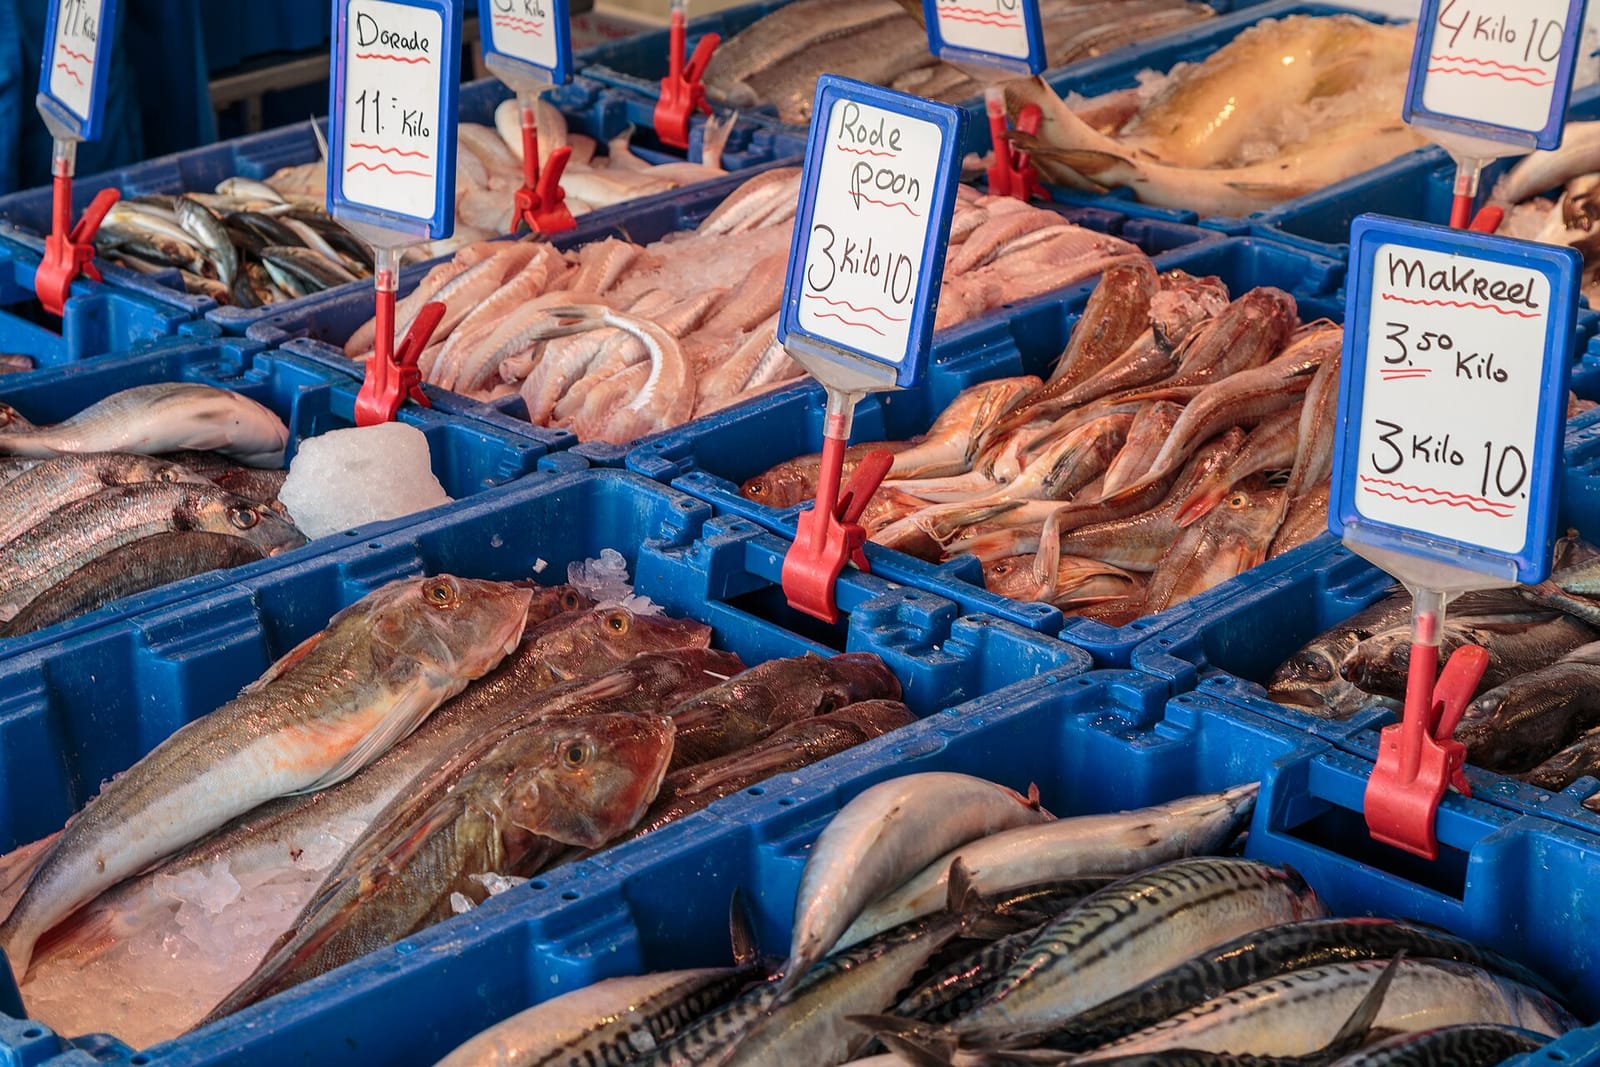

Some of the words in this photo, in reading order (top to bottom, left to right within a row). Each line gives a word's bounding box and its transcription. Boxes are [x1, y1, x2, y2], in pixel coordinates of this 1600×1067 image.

[1439, 0, 1470, 49] 4
[1473, 15, 1516, 43] Kilo
[402, 109, 430, 137] Kilo
[838, 102, 903, 152] Rode
[807, 223, 836, 293] 3
[1455, 350, 1508, 383] Kilo
[1371, 418, 1404, 475] 3
[1412, 433, 1465, 466] Kilo
